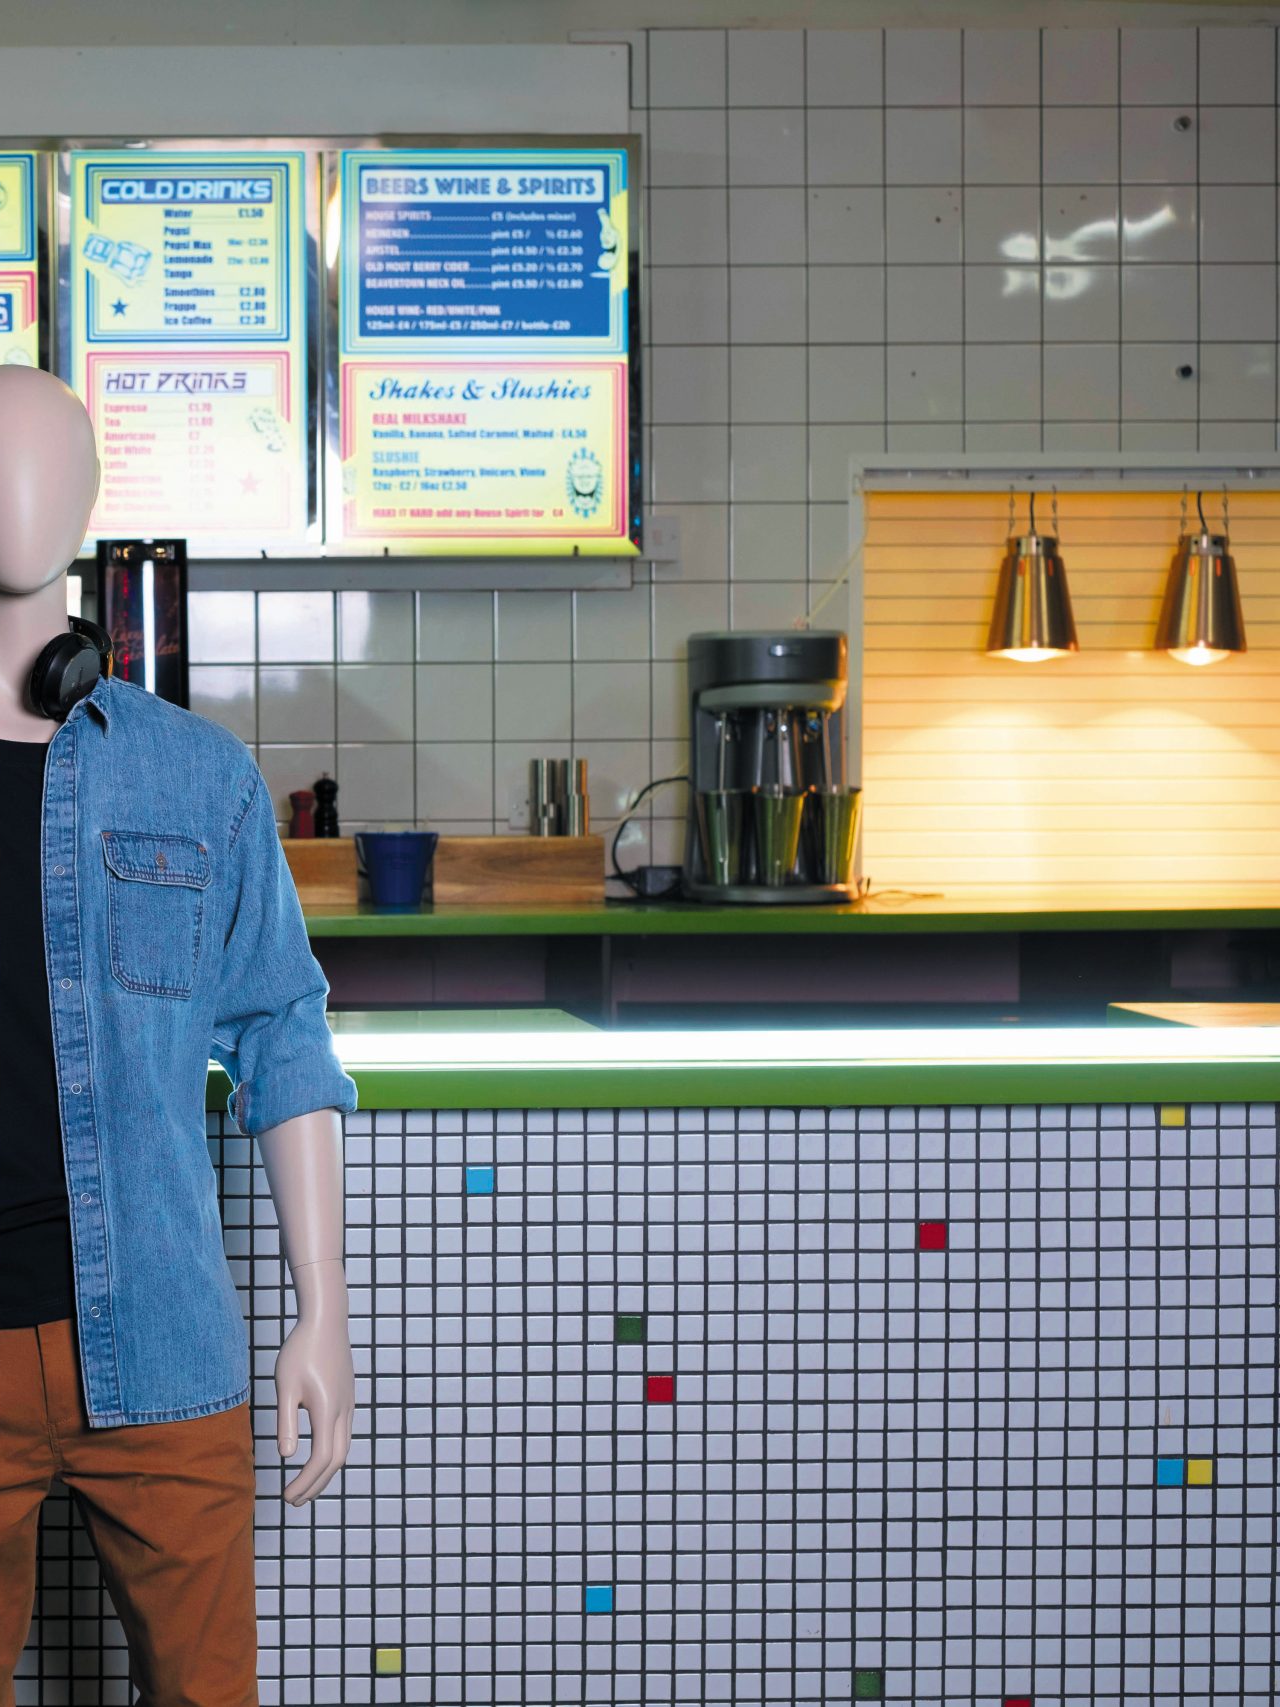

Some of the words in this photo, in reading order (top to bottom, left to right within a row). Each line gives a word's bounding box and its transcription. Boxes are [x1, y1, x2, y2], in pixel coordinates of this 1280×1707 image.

[103, 181, 174, 199] COLD
[177, 180, 271, 199] DRINKS
[366, 178, 429, 195] BEERS
[435, 178, 490, 194] WINE
[496, 178, 512, 194] &
[518, 177, 595, 195] SPIRITS
[164, 209, 192, 218] Water
[366, 211, 395, 221] HOUSE
[397, 211, 431, 221] SPIRITS
[505, 212, 545, 221] (includes
[547, 212, 576, 222] mixer)
[165, 227, 190, 236] Pepsi
[165, 241, 189, 250] Pepsi
[165, 255, 213, 264] Lemonade
[366, 262, 384, 272] OLD
[413, 262, 442, 272] BERRY
[444, 262, 469, 272] CIDER
[427, 278, 450, 289] NECK
[165, 288, 215, 296] Smoothies
[165, 302, 196, 311] Frappe
[366, 305, 395, 315] HOUSE
[165, 317, 178, 325] Ice
[182, 316, 212, 325] Coffee
[106, 372, 150, 391] HOT
[156, 372, 247, 393] DRINKS
[370, 378, 455, 400] Shakes
[462, 380, 484, 400] &
[491, 377, 591, 400] Slushies
[104, 404, 147, 413] Espresso
[373, 413, 399, 425] REAL
[403, 413, 467, 425] MILKSHAKE
[104, 432, 156, 441] Americano
[448, 429, 477, 439] Salted
[523, 429, 554, 438] Malted
[373, 451, 420, 463] SLUSHIE
[410, 508, 433, 518] HARD
[436, 508, 453, 518] add
[474, 508, 502, 518] House
